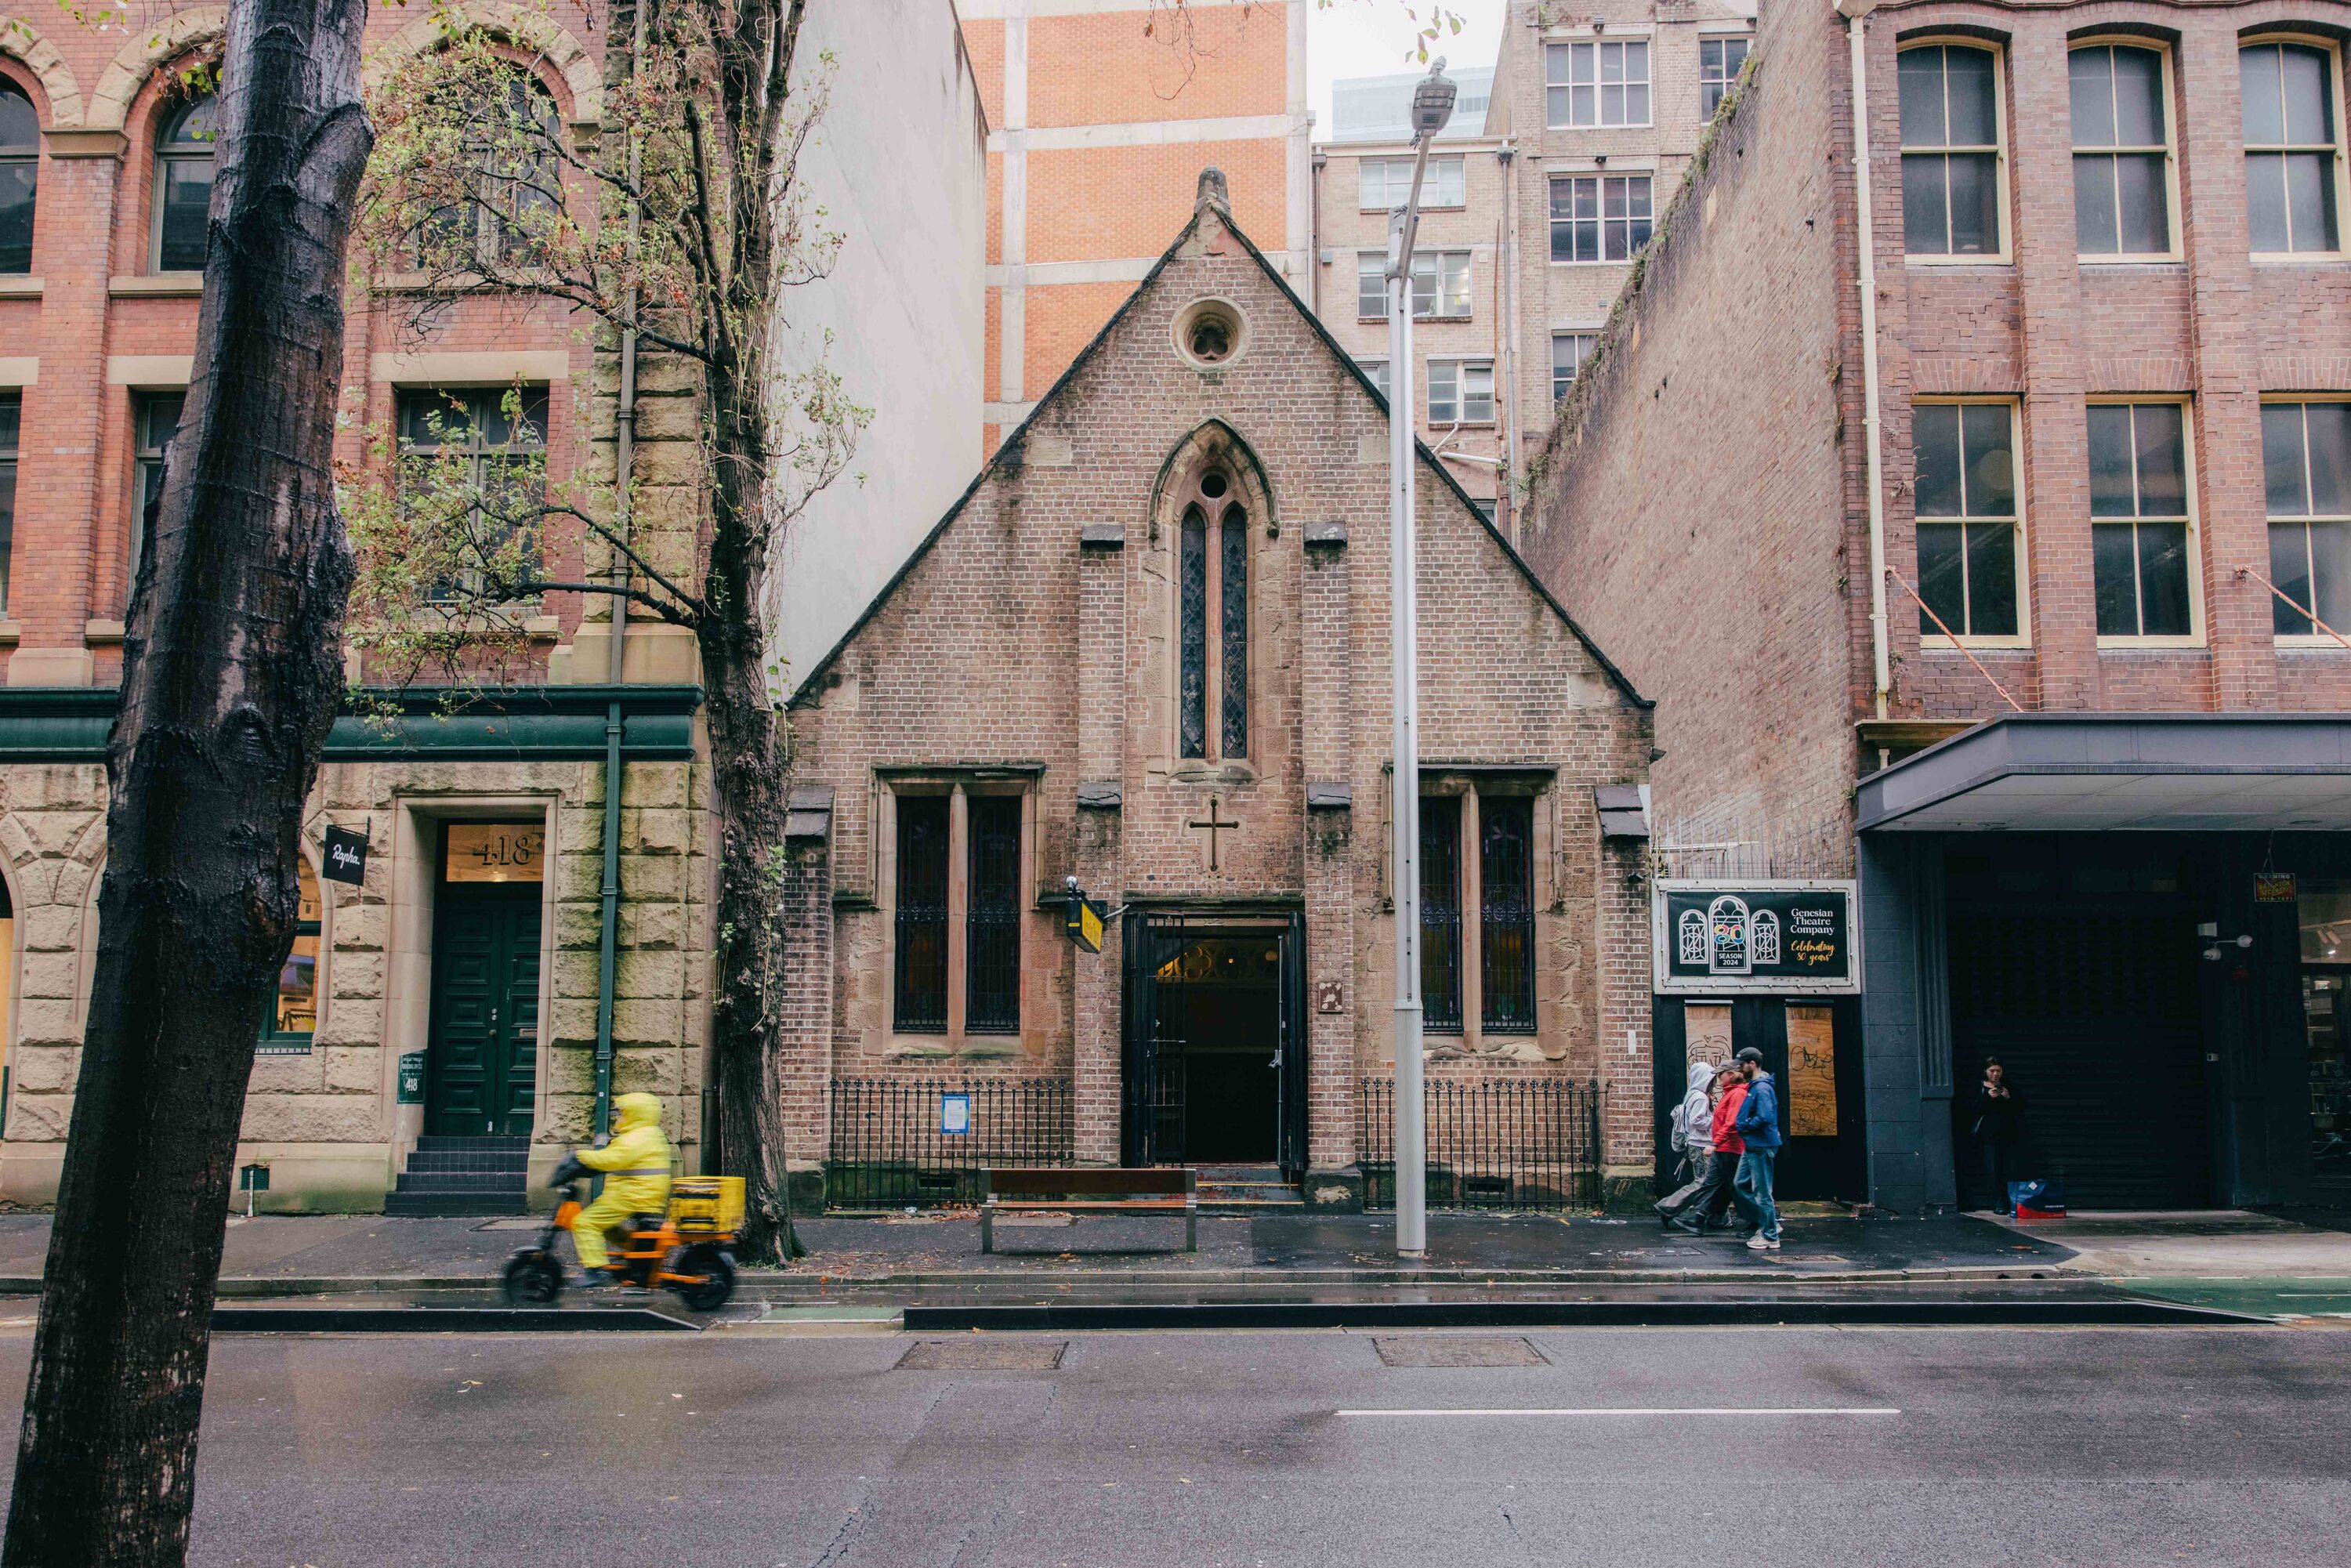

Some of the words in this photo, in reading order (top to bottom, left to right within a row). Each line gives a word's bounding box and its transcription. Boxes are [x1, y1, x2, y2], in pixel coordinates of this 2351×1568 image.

[473, 835, 534, 866] 418
[1791, 908, 1834, 917] Genesian
[1793, 916, 1831, 925] Theatre
[1714, 924, 1746, 945] 80
[1790, 925, 1835, 936] Company
[1791, 940, 1835, 956] Celebrating
[1797, 952, 1806, 961] 80
[1808, 954, 1830, 965] years
[406, 1077, 418, 1092] 418
